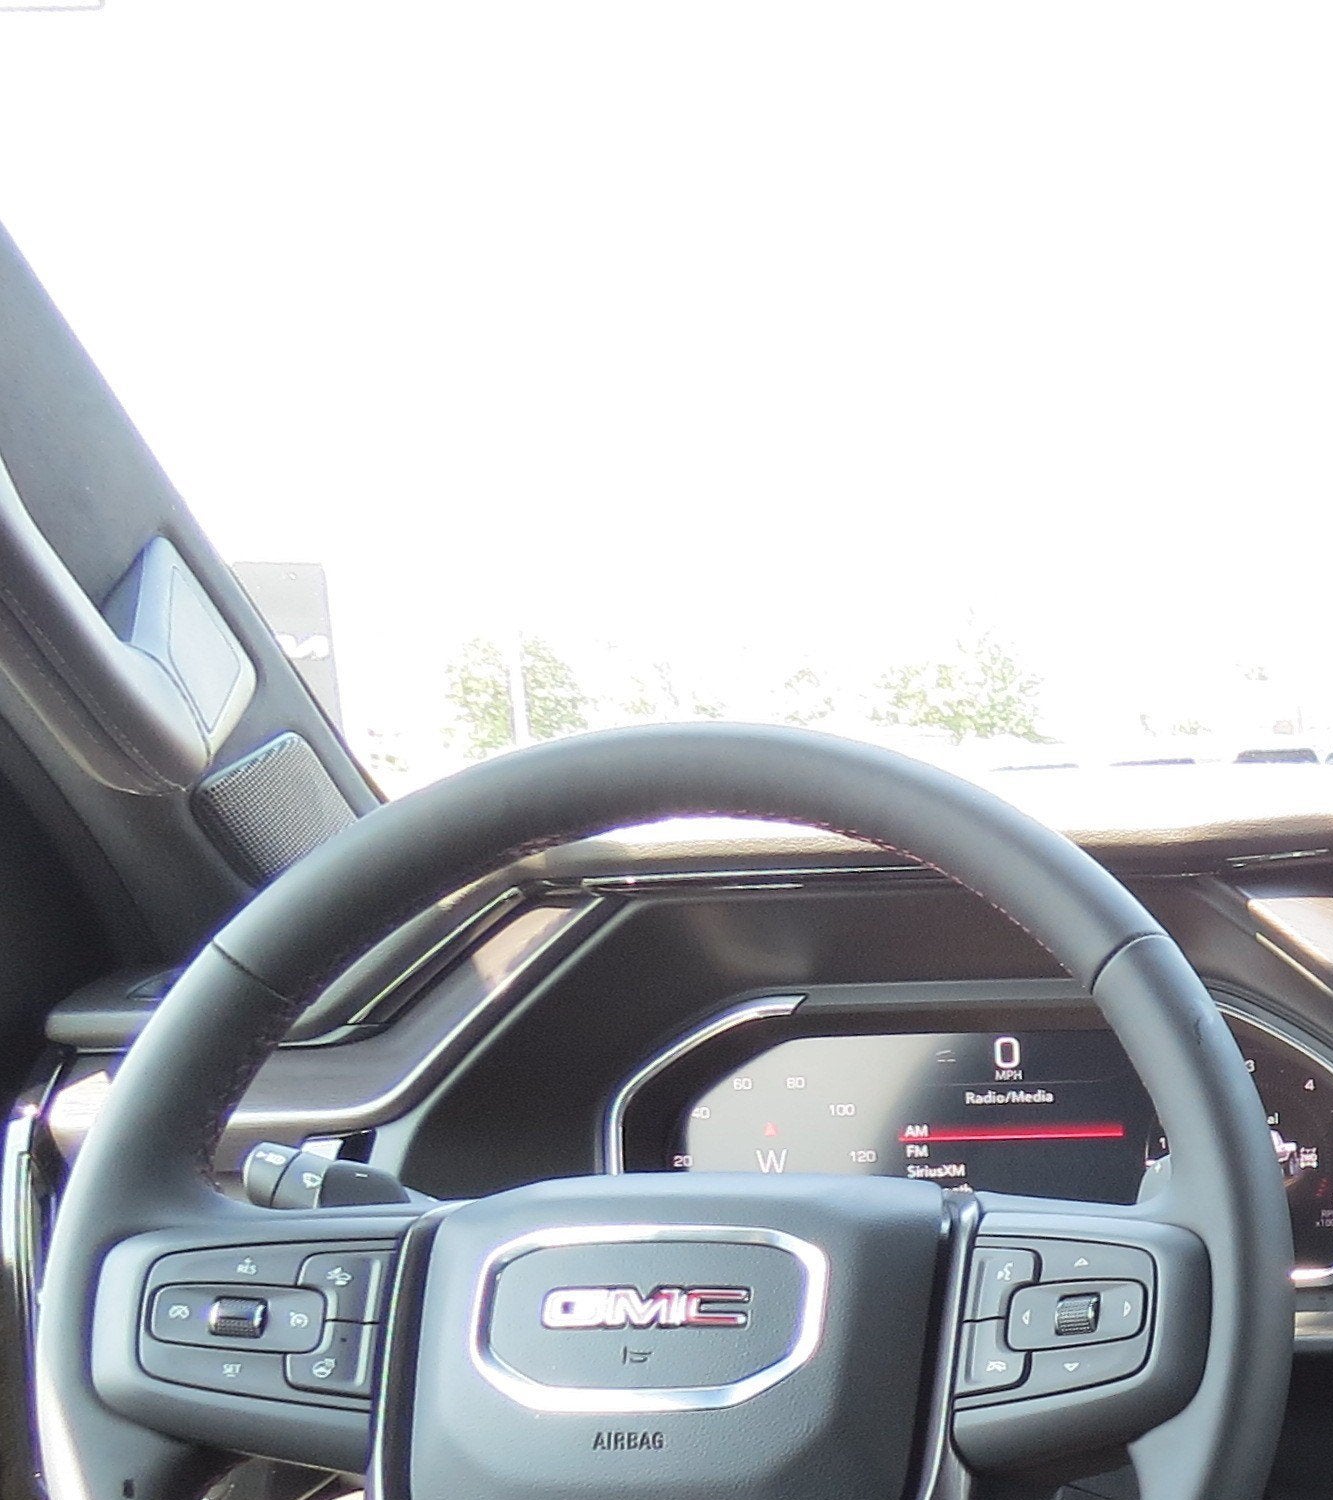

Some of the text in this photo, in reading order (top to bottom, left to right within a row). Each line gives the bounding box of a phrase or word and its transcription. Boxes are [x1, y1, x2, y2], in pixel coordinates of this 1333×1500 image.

[994, 1037, 1020, 1068] 0
[1245, 1059, 1256, 1072] 3
[995, 1069, 1022, 1082] MPH
[734, 1078, 752, 1090] 60
[786, 1077, 806, 1089] 80
[1304, 1078, 1314, 1091] 4
[965, 1089, 1054, 1105] Radio/Media
[692, 1107, 710, 1120] 40
[828, 1104, 856, 1116] 100
[904, 1124, 929, 1138] AM
[849, 1151, 876, 1163] 120
[906, 1144, 928, 1158] FM
[673, 1155, 692, 1168] 20
[756, 1149, 788, 1174] W
[907, 1163, 966, 1178] SiriusXM
[542, 1285, 752, 1329] GMC
[223, 1364, 241, 1374] SET
[594, 1431, 664, 1451] AIRBAG
